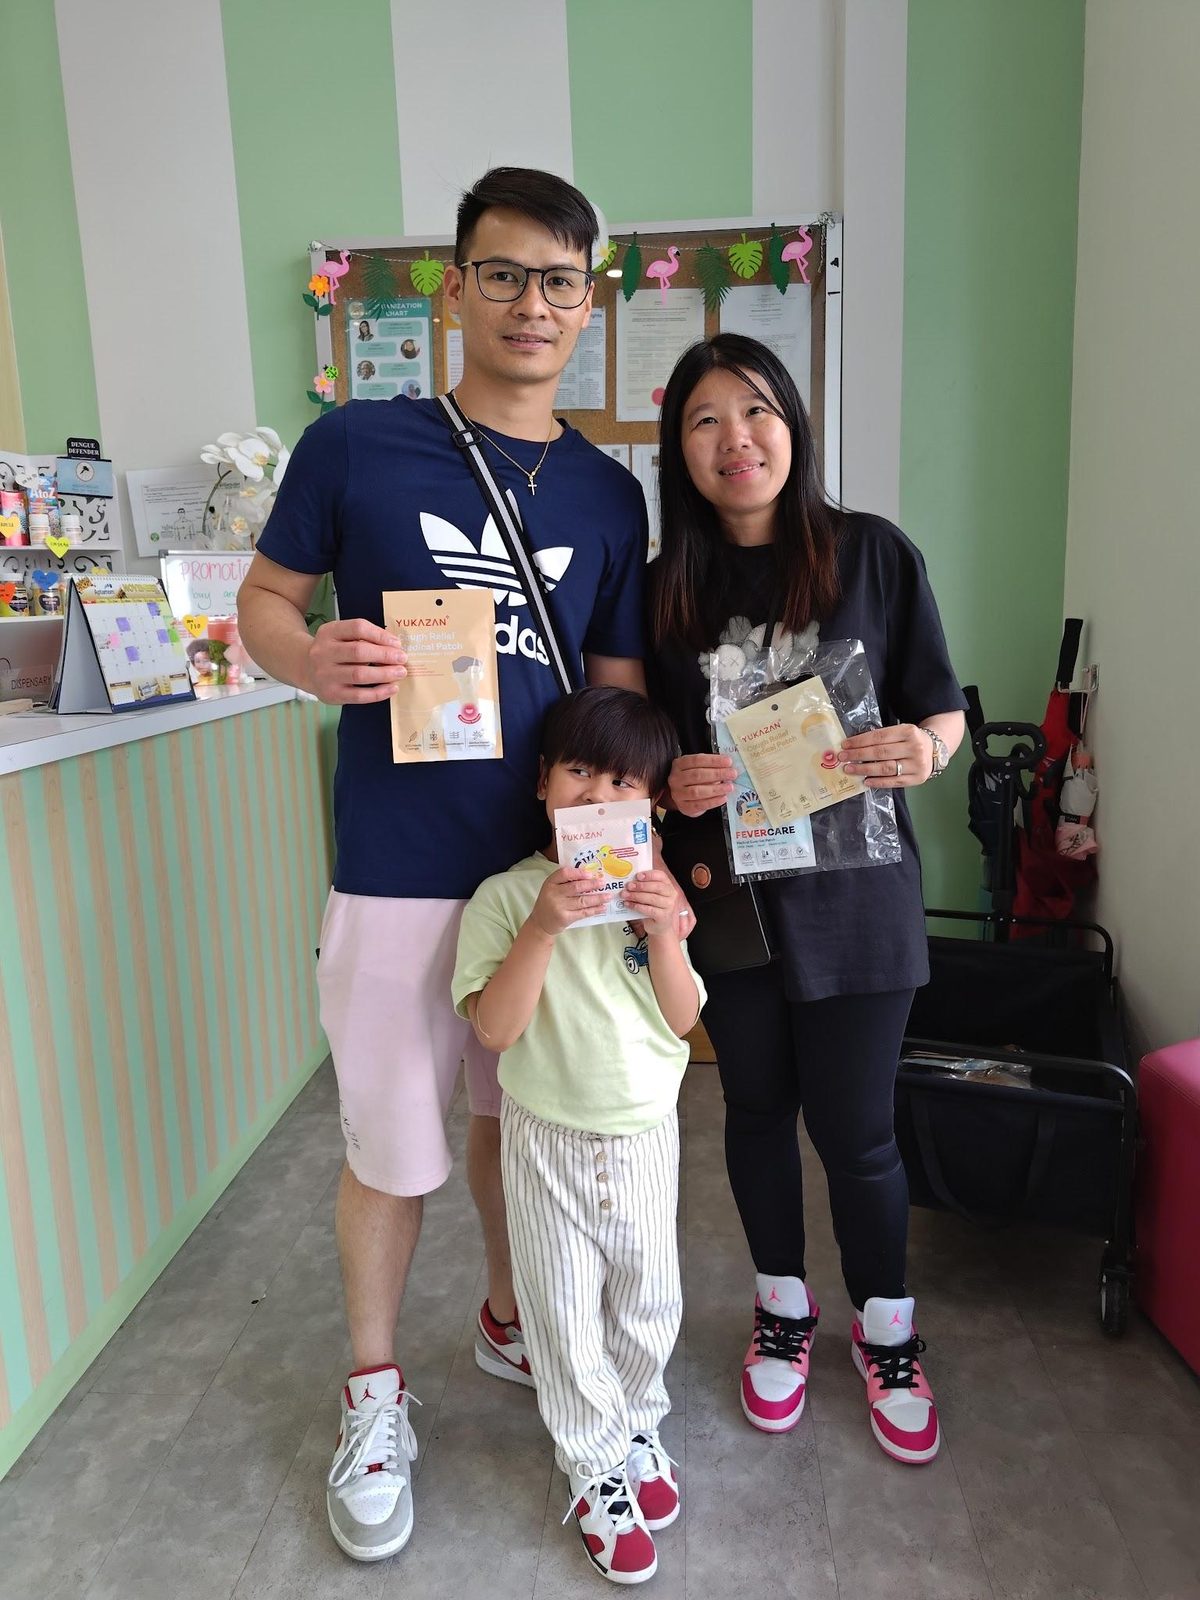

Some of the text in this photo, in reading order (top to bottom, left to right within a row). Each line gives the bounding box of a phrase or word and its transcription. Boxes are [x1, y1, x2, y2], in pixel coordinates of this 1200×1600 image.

[71, 441, 96, 449] DENGUE
[68, 447, 100, 456] DEFENDER
[395, 618, 447, 627] YUKAZAN
[436, 642, 463, 651] Patch
[11, 675, 52, 690] DISPENSARY
[741, 721, 781, 743] YUKAZAN
[776, 735, 798, 748] Patch
[561, 831, 603, 842] YUKAZAN
[736, 825, 796, 839] FEVERCARE
